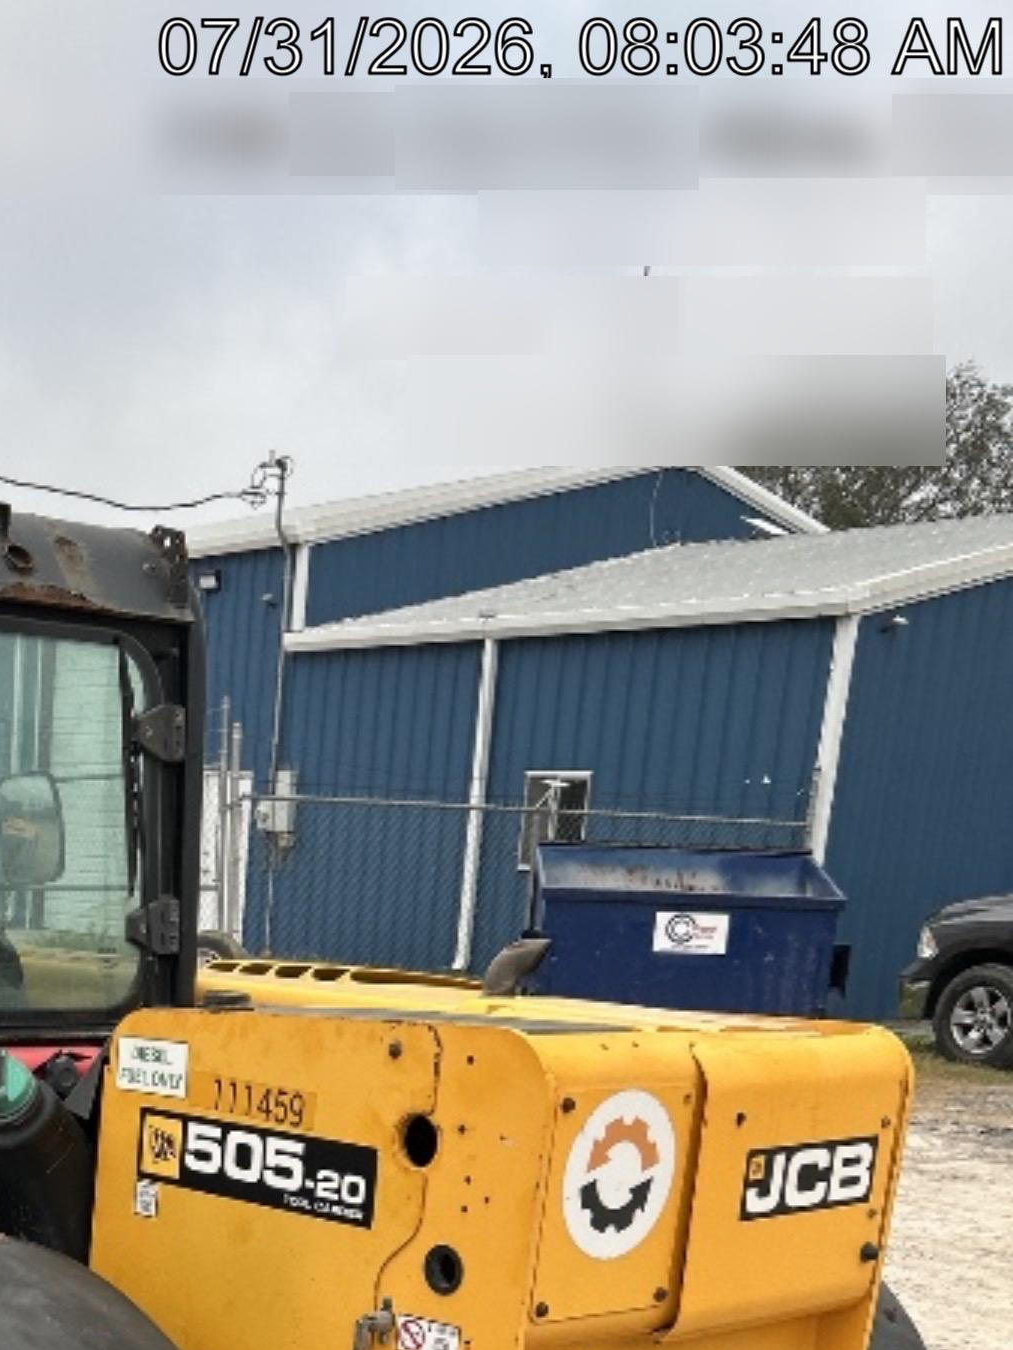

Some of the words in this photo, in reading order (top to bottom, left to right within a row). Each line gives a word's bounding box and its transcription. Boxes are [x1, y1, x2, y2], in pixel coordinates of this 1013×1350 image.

[119, 1067, 149, 1086] FUEL
[151, 1070, 183, 1089] ONLY
[214, 1078, 306, 1128] 111459
[746, 1142, 873, 1213] JCB
